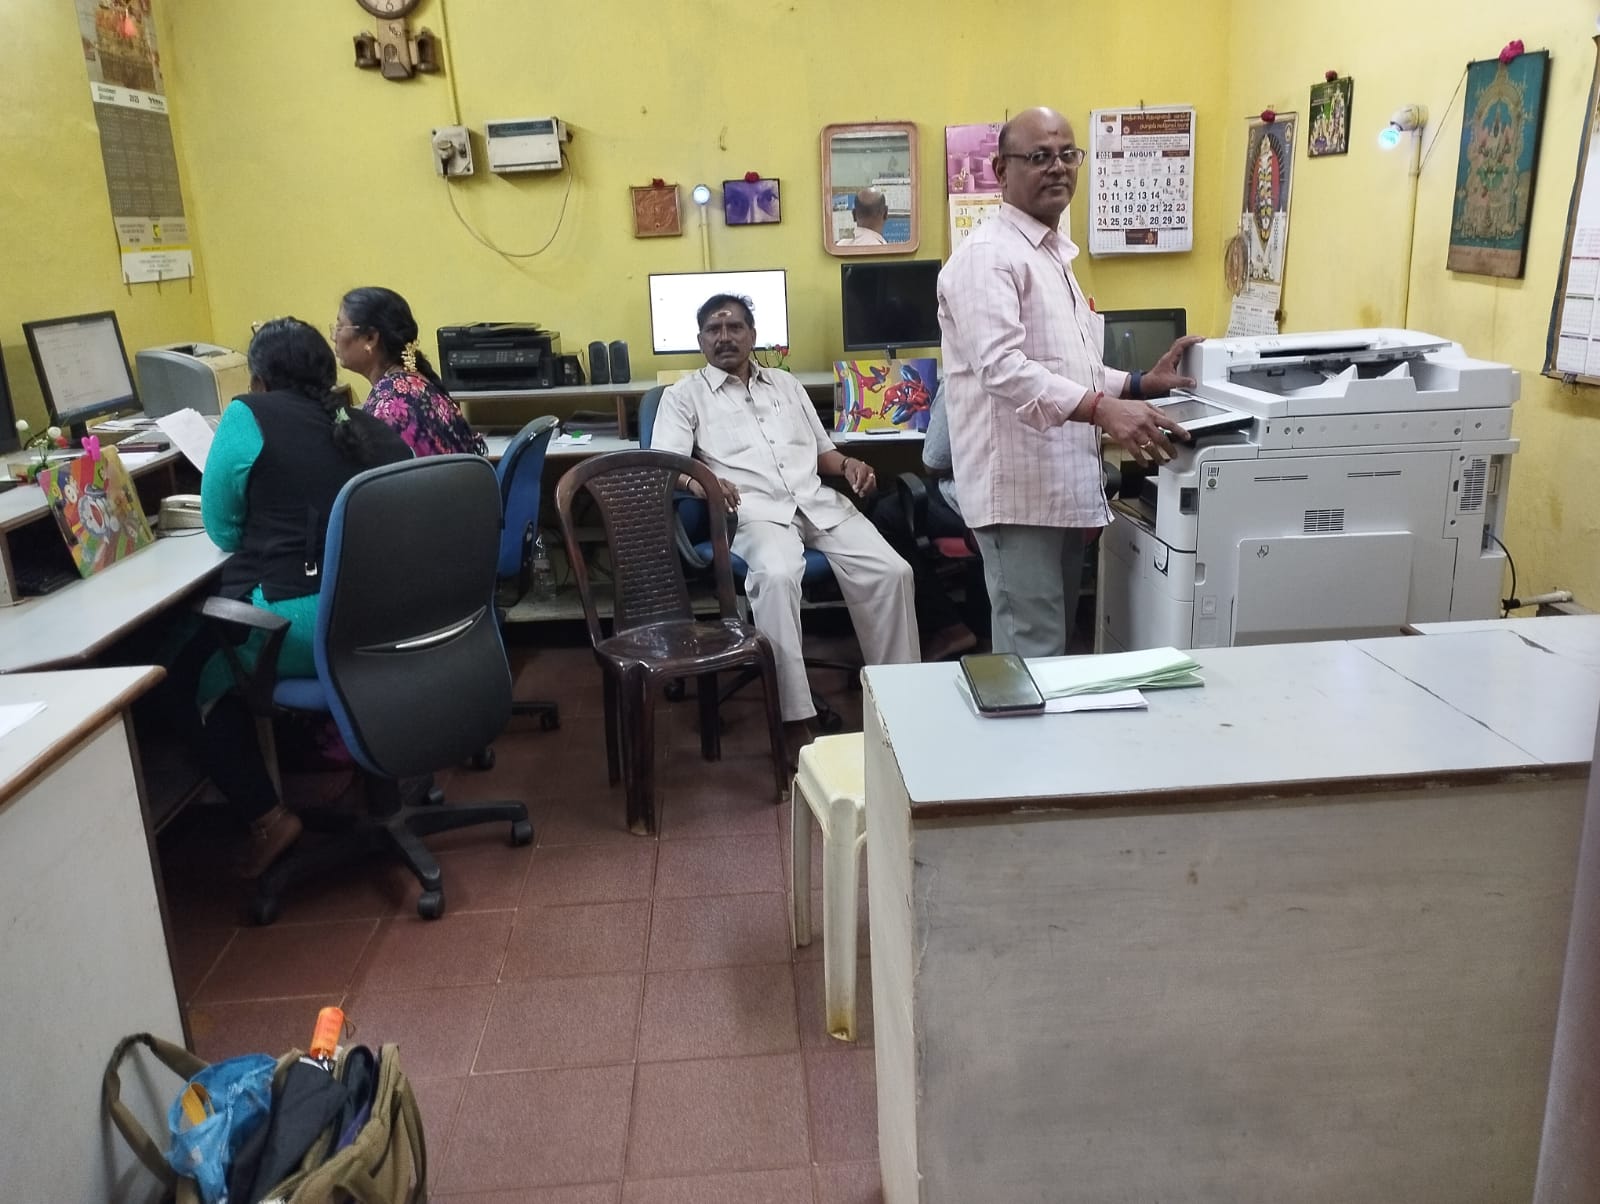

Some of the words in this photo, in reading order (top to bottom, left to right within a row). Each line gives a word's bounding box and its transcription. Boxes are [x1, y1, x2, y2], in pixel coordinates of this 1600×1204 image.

[1097, 167, 1107, 175] 31
[1179, 164, 1185, 174] 2
[1099, 180, 1105, 188] 3
[1113, 179, 1119, 187] 4
[1126, 179, 1132, 187] 5
[1139, 178, 1145, 187] 6
[1153, 178, 1158, 186] 7
[1166, 178, 1172, 186] 8
[1179, 177, 1185, 186] 9
[1098, 193, 1107, 201] 10
[1111, 192, 1119, 200] 11
[1125, 191, 1134, 200] 12
[1138, 191, 1147, 200] 13
[1151, 191, 1160, 199] 14
[1098, 205, 1107, 214] 17
[1110, 205, 1120, 213] 18
[1124, 205, 1133, 213] 19
[1137, 204, 1147, 212] 20
[1150, 204, 1159, 212] 21
[1163, 203, 1173, 212] 22
[1176, 203, 1186, 212] 23
[1097, 217, 1107, 226] 24
[1110, 217, 1120, 226] 25
[1123, 217, 1133, 226] 26
[1149, 216, 1159, 225] 28
[1162, 216, 1172, 225] 29
[1175, 216, 1186, 224] 30
